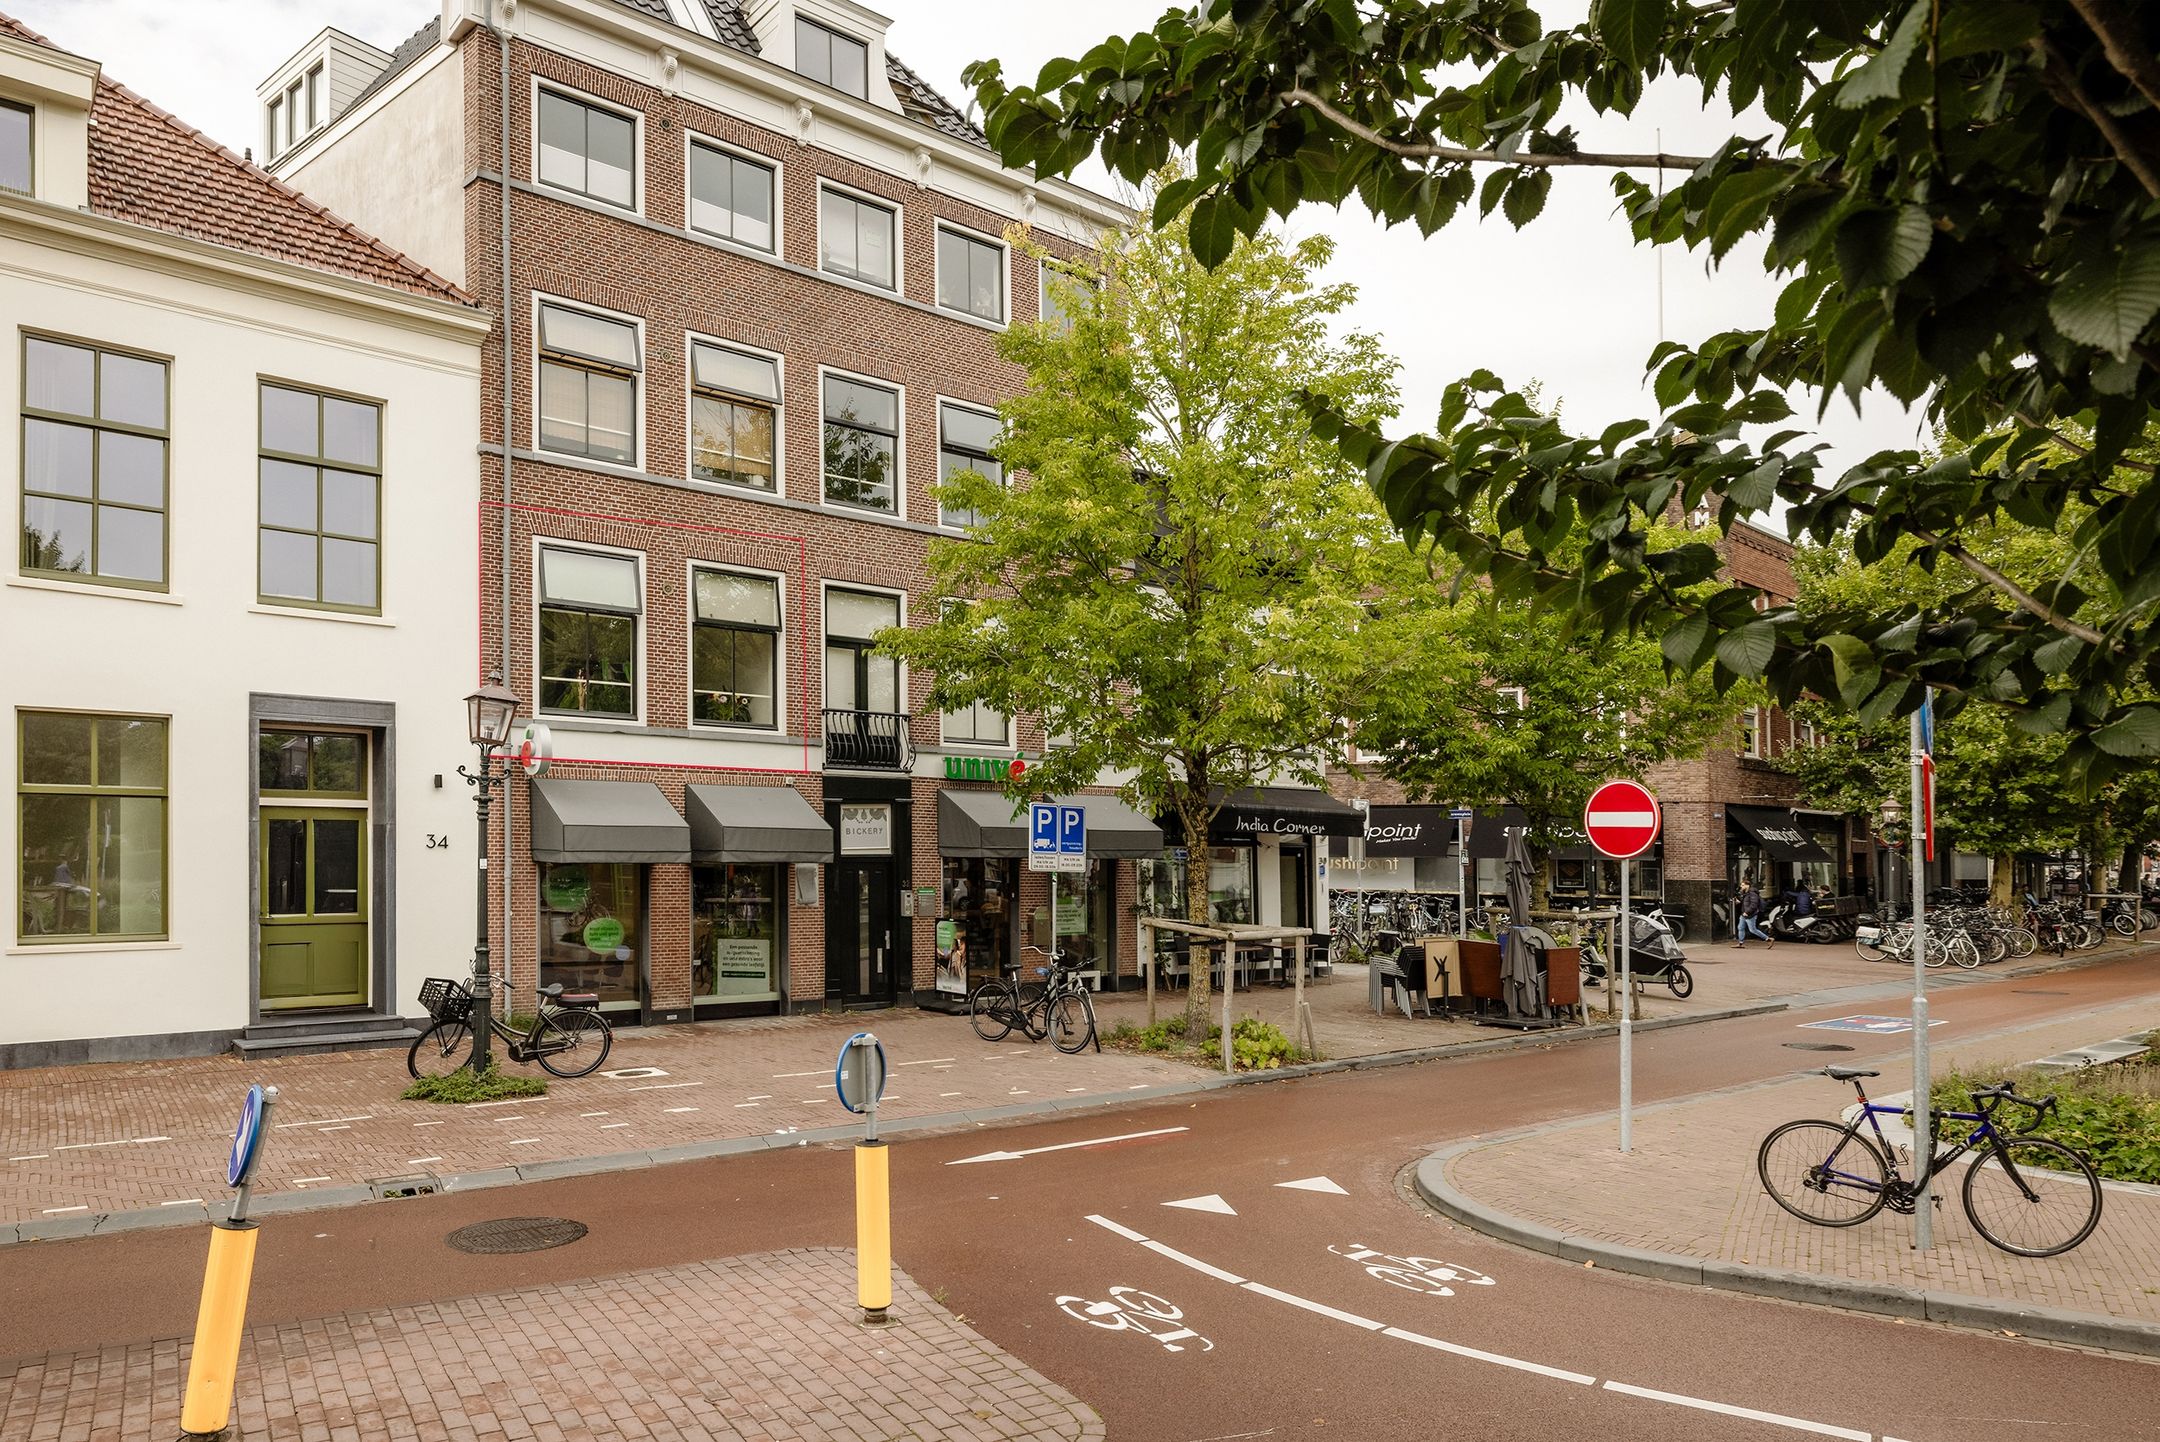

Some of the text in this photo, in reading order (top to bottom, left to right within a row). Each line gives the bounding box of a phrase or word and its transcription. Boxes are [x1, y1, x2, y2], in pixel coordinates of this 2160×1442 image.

[943, 752, 1026, 782] univé
[845, 827, 883, 835] BICKERY
[1038, 809, 1052, 833] P
[1065, 811, 1079, 835] P
[1235, 816, 1325, 834] India Corner
[426, 834, 448, 849] 34
